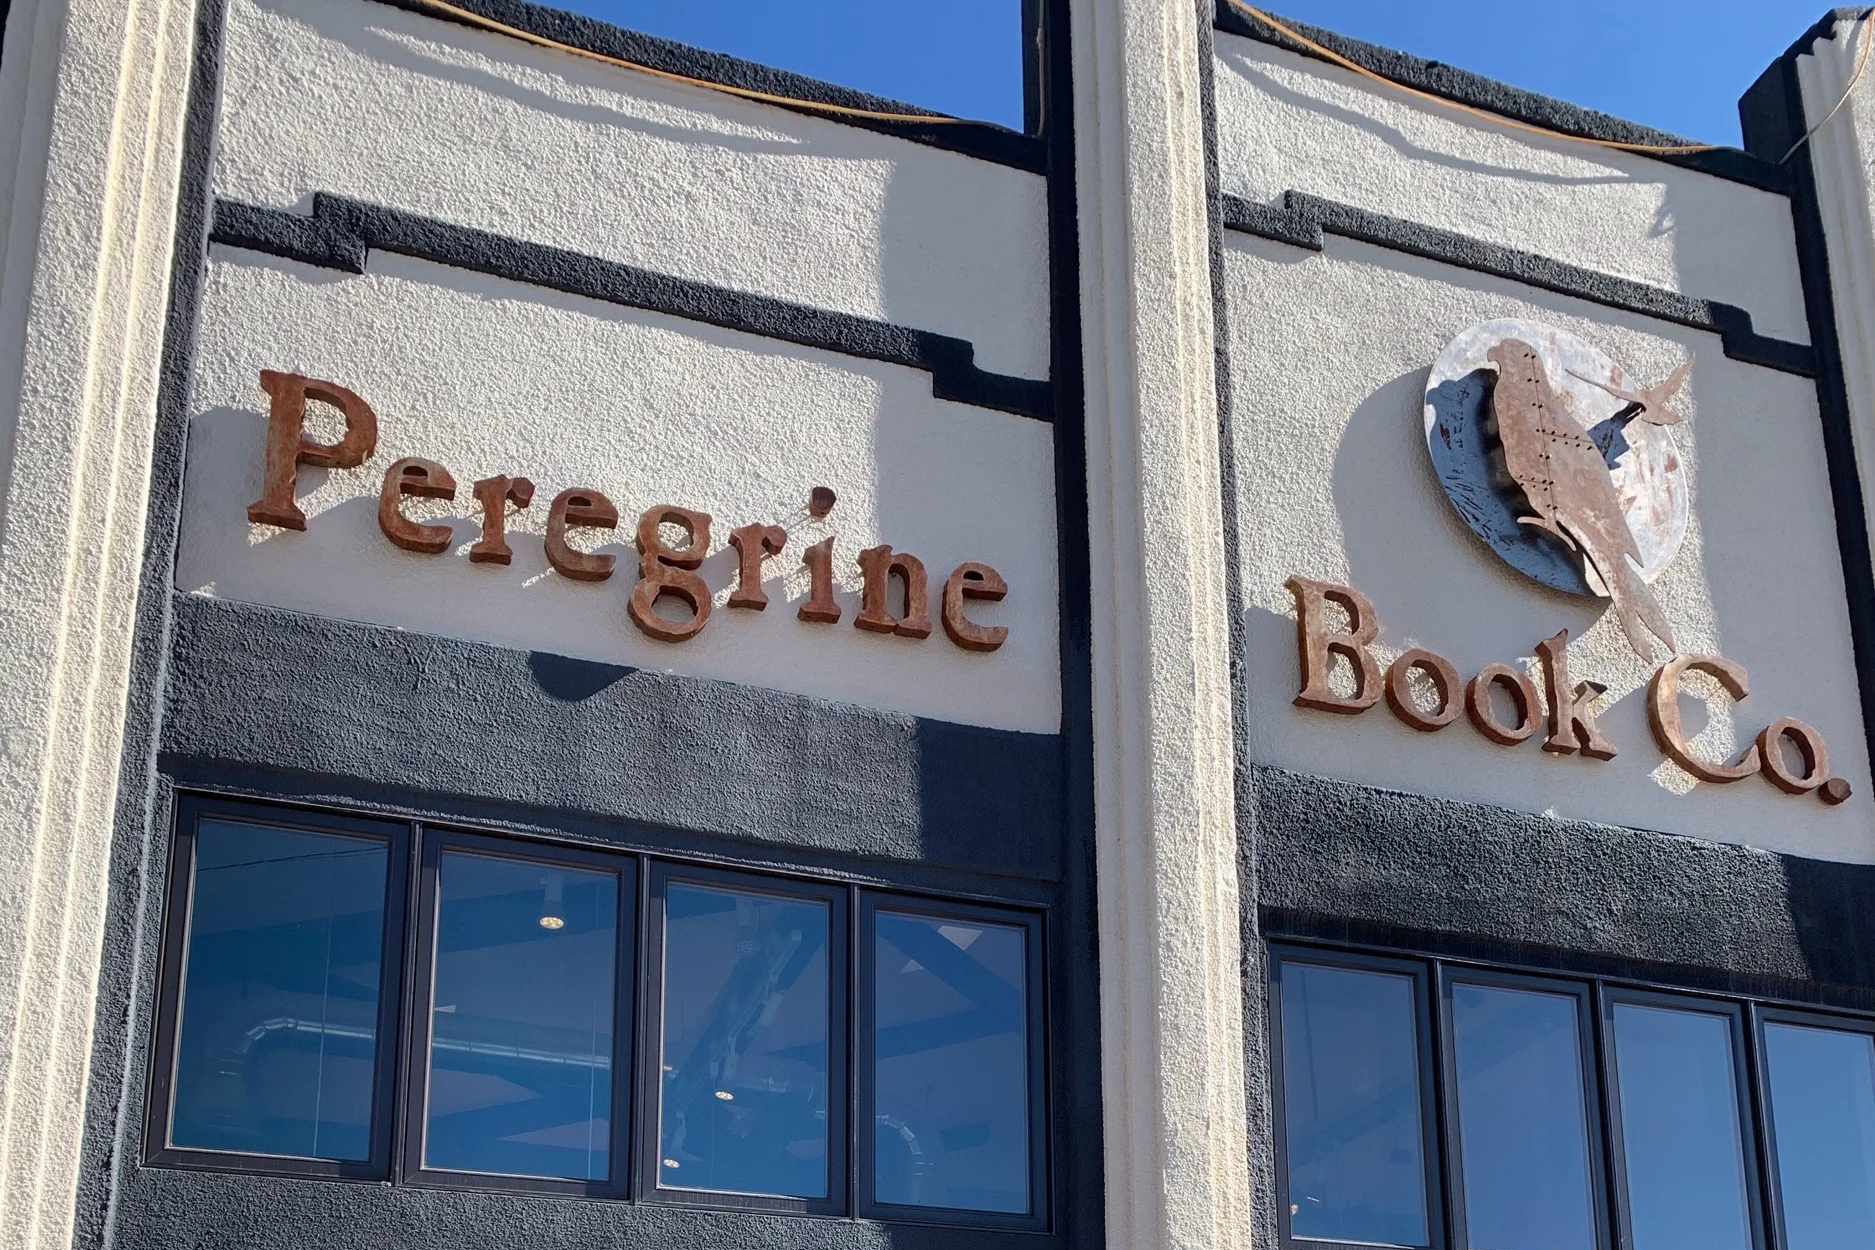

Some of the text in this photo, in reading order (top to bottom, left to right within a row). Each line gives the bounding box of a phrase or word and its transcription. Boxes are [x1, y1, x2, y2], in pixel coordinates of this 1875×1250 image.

[247, 369, 1008, 652] Peregrine
[1283, 574, 1853, 806] Book Co.
